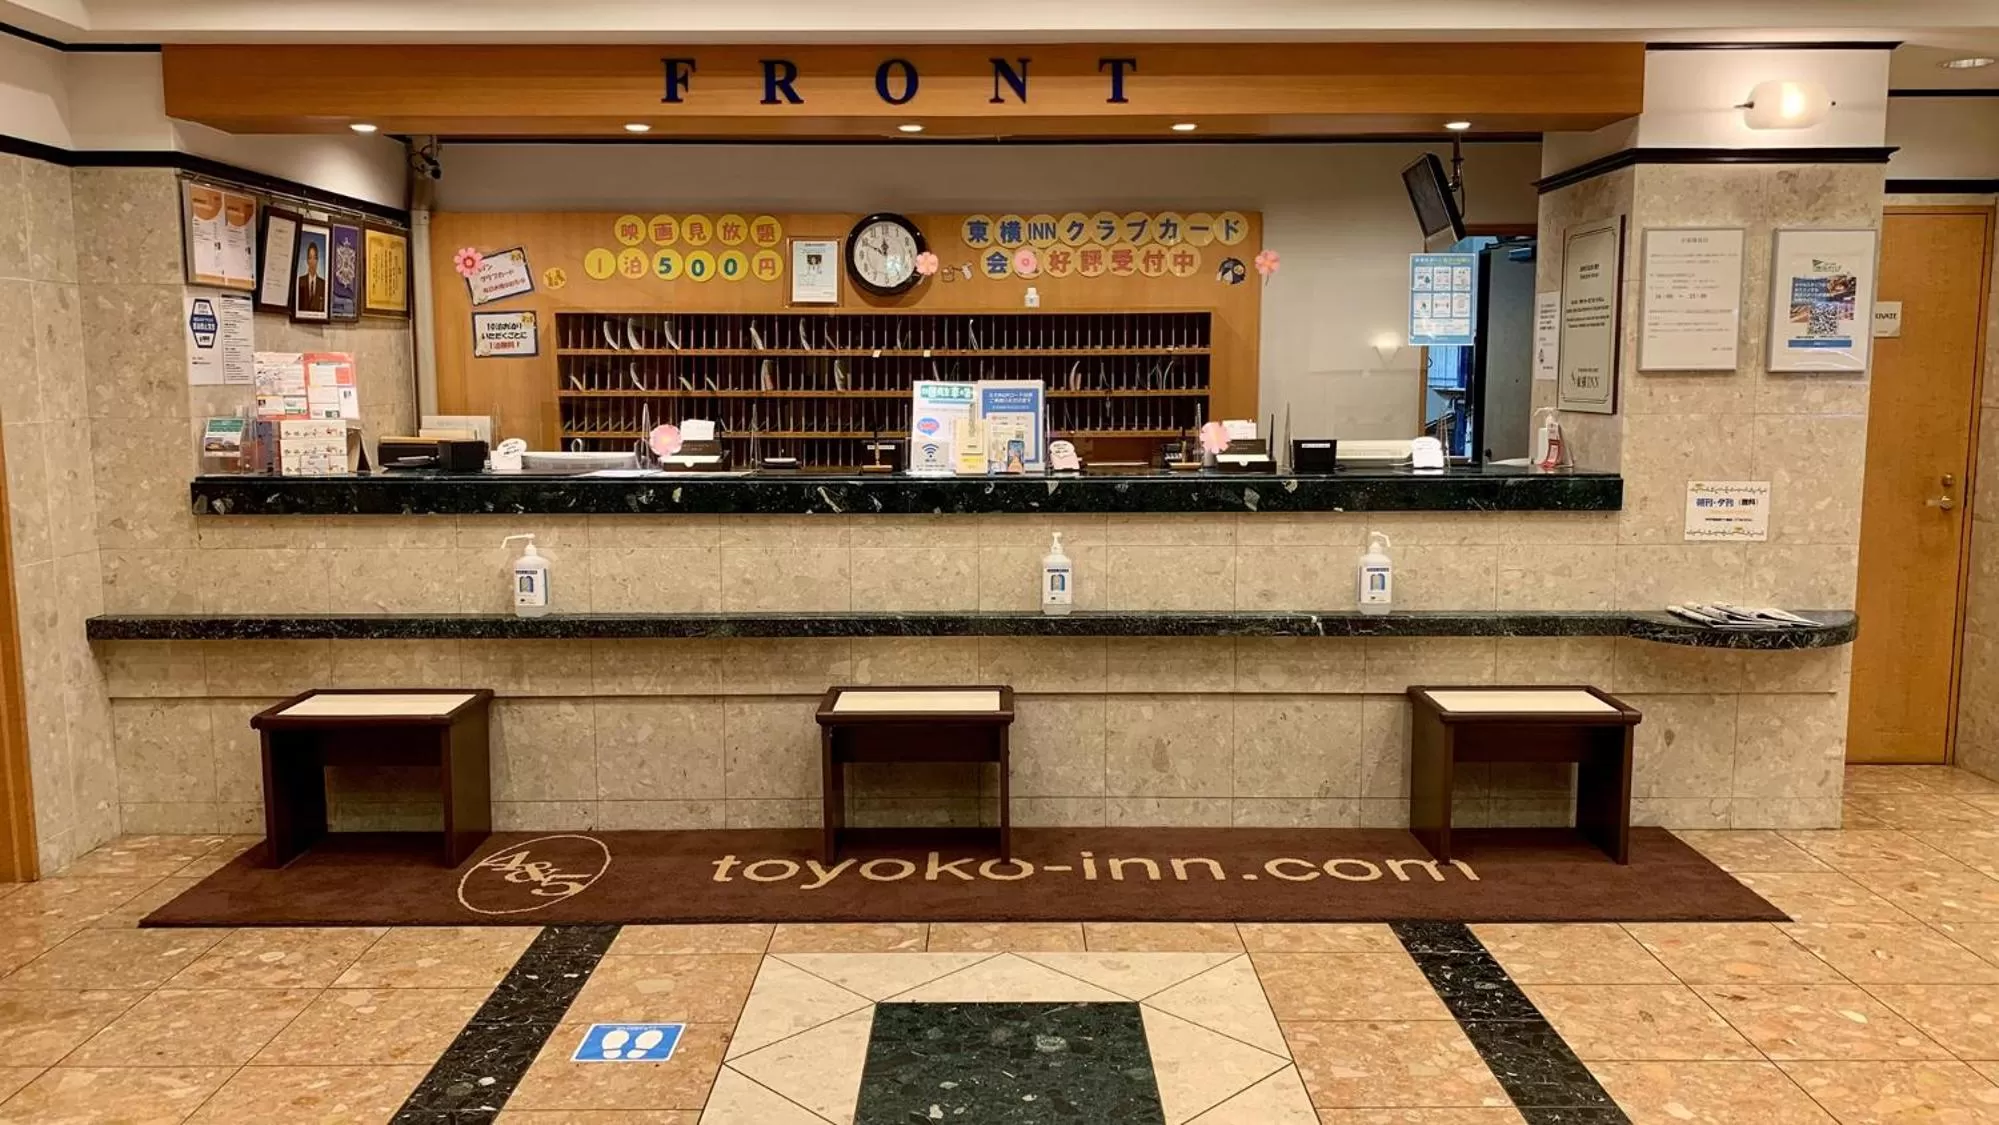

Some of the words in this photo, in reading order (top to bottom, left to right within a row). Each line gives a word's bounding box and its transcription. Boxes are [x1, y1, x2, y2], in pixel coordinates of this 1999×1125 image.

[660, 58, 1137, 105] FRONT
[620, 221, 776, 244] 映画見放題
[967, 218, 1241, 244] 東横INNクラブカード
[594, 256, 777, 277] 1泊500円
[985, 250, 1196, 276] 会好評受付中
[711, 851, 1481, 890] toyoko-inn.com
